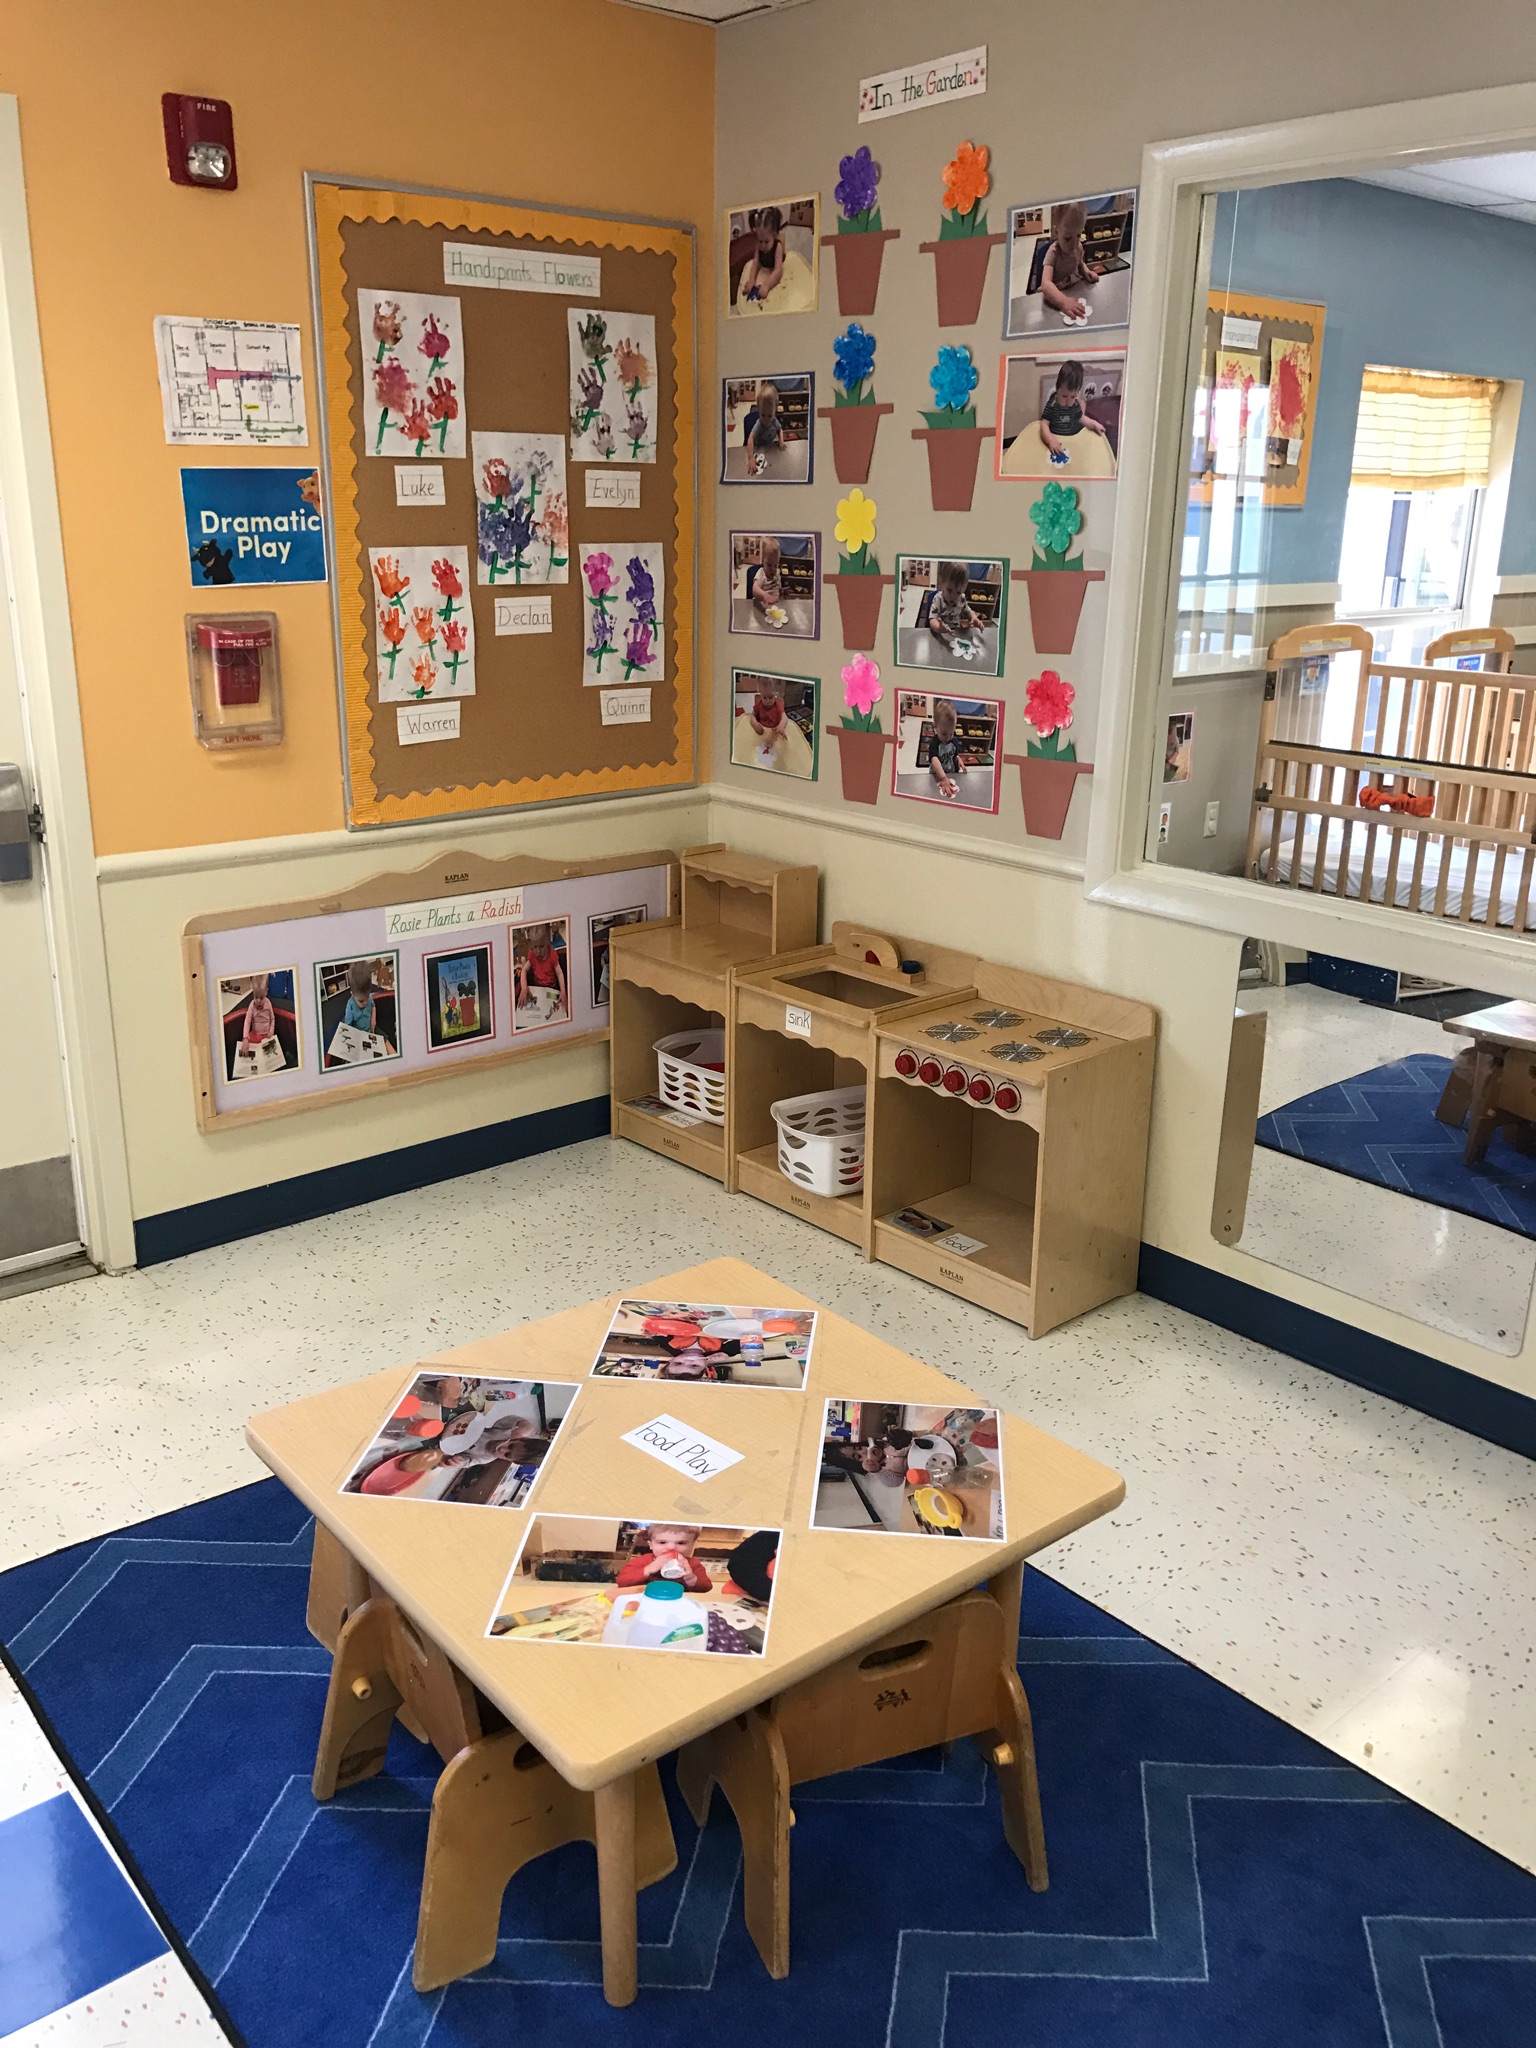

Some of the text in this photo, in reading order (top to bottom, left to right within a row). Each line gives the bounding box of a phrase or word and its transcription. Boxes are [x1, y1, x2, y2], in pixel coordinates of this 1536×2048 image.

[871, 62, 973, 111] In the Garden
[197, 103, 217, 112] FIRE
[543, 261, 594, 287] Flowers
[400, 474, 435, 497] Luke
[592, 477, 635, 506] Evelyn
[200, 508, 321, 534] Dramatic
[237, 534, 292, 564] Play
[498, 605, 551, 626] Declan
[606, 696, 646, 717] Quinn
[406, 713, 456, 735] Warren
[224, 735, 240, 743] LIFT
[444, 872, 469, 881] KAPLAN
[389, 896, 521, 934] Rosie Plants a Radish
[939, 1266, 964, 1282] KAPLAN
[634, 1421, 718, 1477] Food Play
